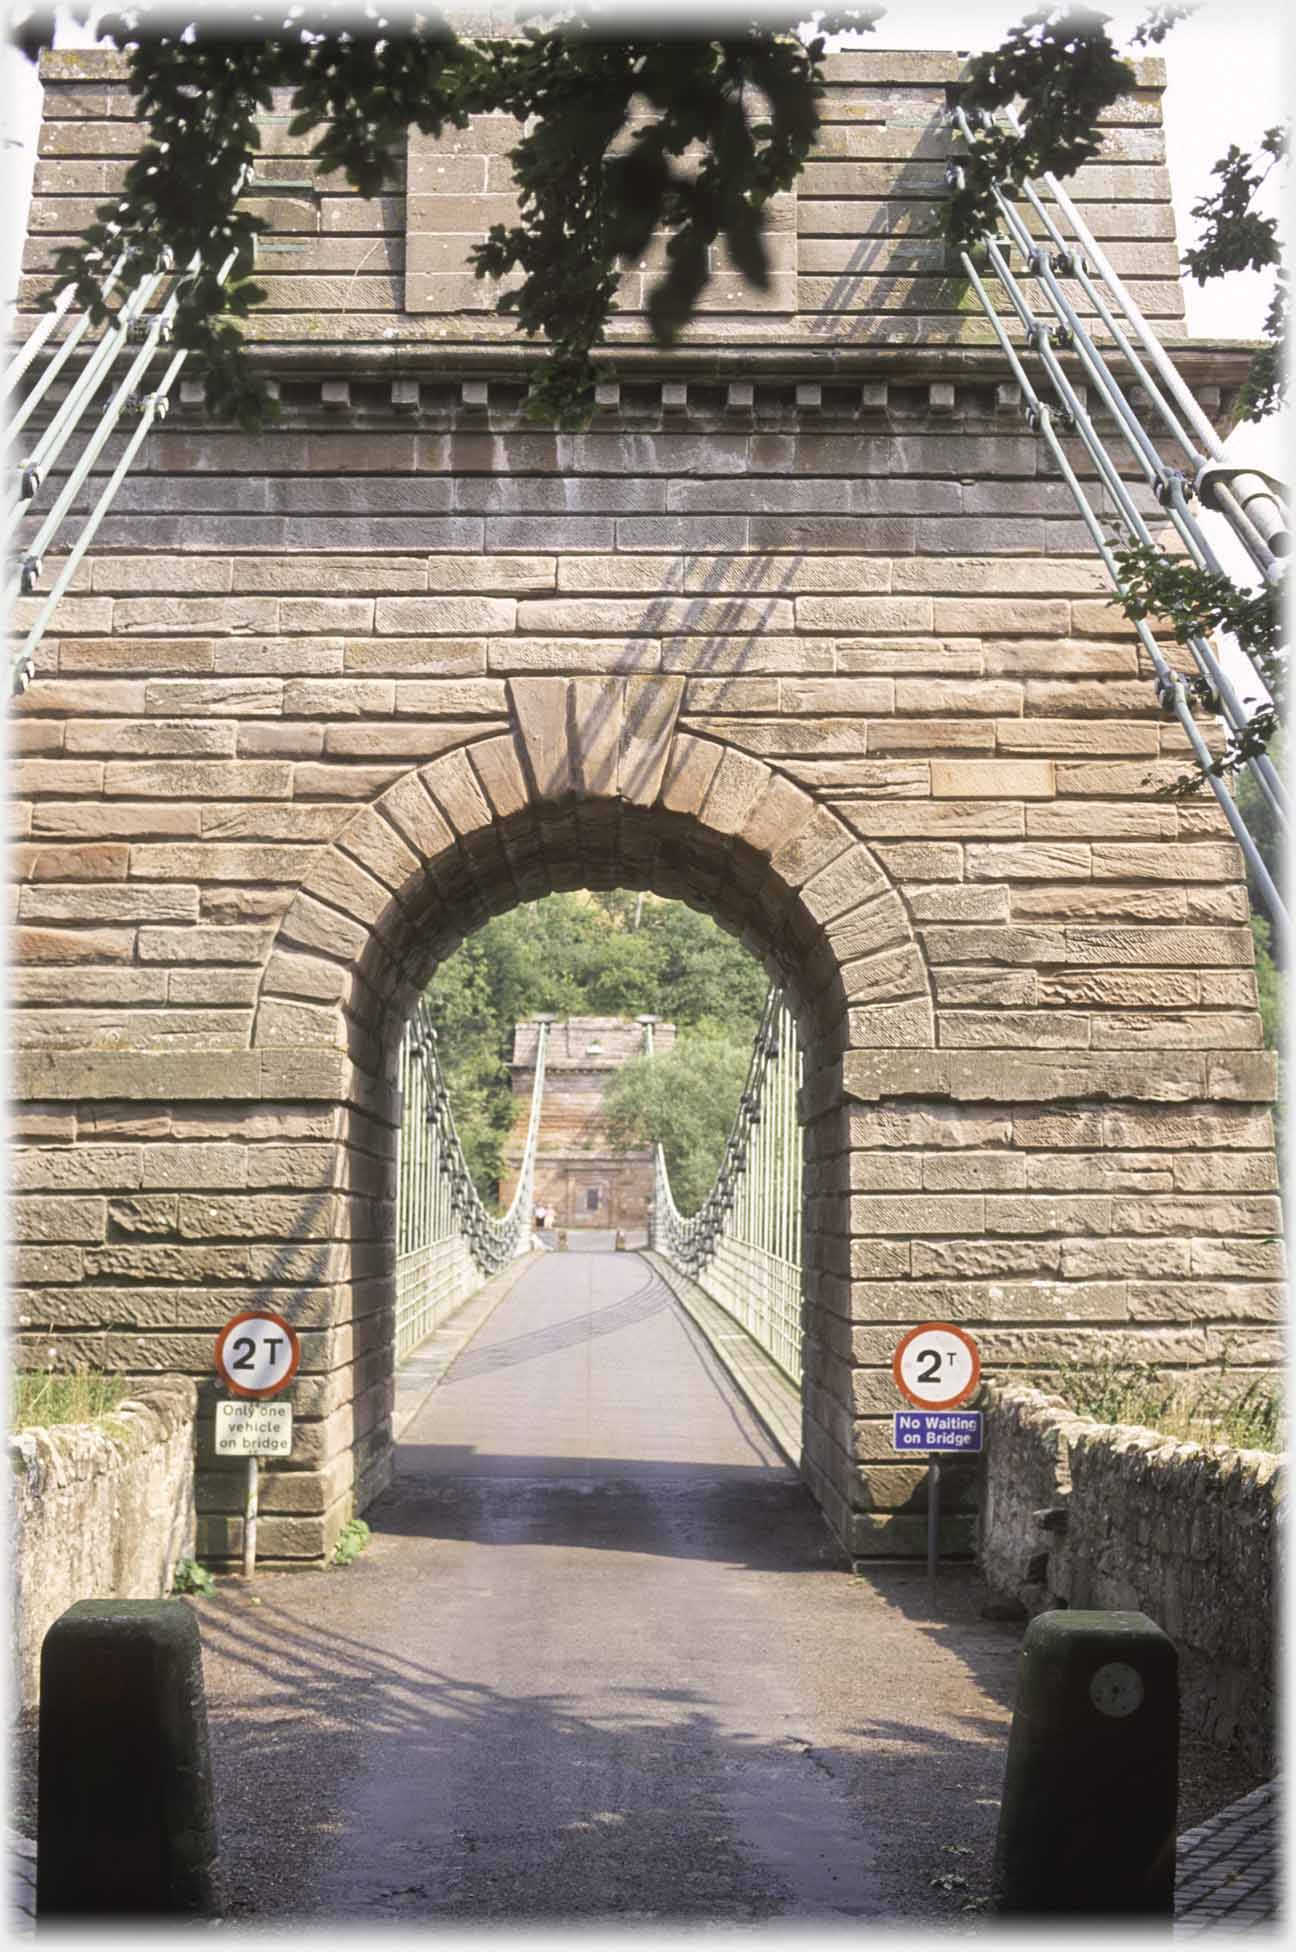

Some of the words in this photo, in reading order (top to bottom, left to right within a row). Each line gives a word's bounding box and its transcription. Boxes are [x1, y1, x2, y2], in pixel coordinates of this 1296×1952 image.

[223, 1404, 255, 1418] Only
[260, 1406, 285, 1417] one
[228, 1421, 281, 1433] vehicle
[900, 1416, 920, 1429] No
[925, 1416, 977, 1431] Waiting
[219, 1438, 236, 1448] on
[242, 1436, 288, 1450] bridge
[903, 1433, 921, 1444] on
[926, 1432, 971, 1446] Bridge
